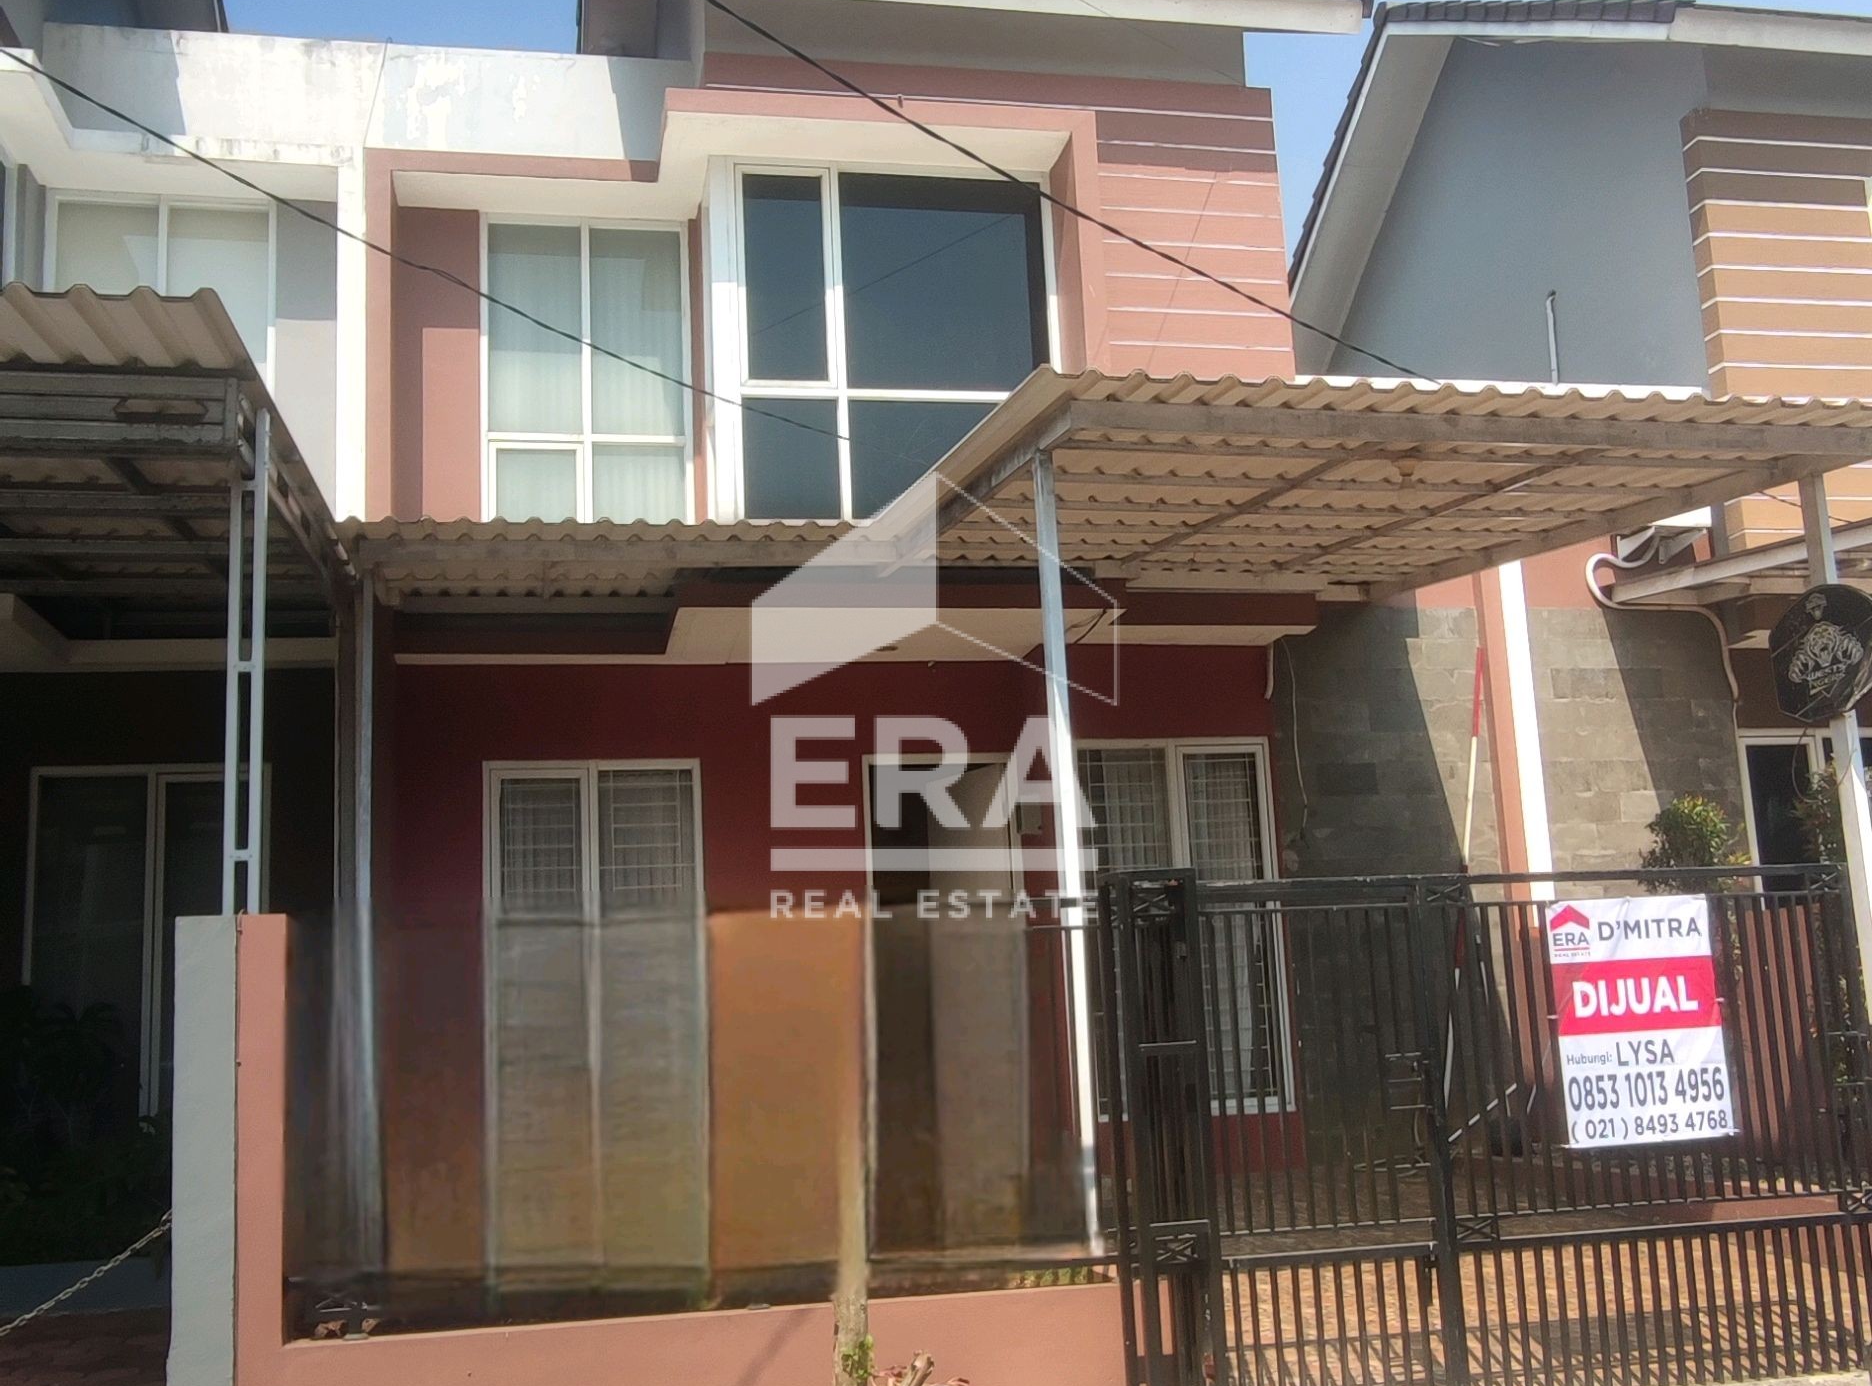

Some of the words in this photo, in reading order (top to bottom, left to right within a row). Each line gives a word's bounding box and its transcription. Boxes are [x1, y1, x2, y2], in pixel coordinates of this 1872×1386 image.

[1552, 932, 1589, 946] ERA
[1572, 975, 1698, 1018] DIJUAL
[1566, 1051, 1612, 1066] Hubungi:
[1616, 1038, 1675, 1067] LYSA
[1568, 1074, 1620, 1112] 0853
[1625, 1070, 1668, 1108] 1013
[1674, 1066, 1725, 1103] 4956
[1634, 1113, 1679, 1136] 8493
[1685, 1109, 1728, 1132] 4768
